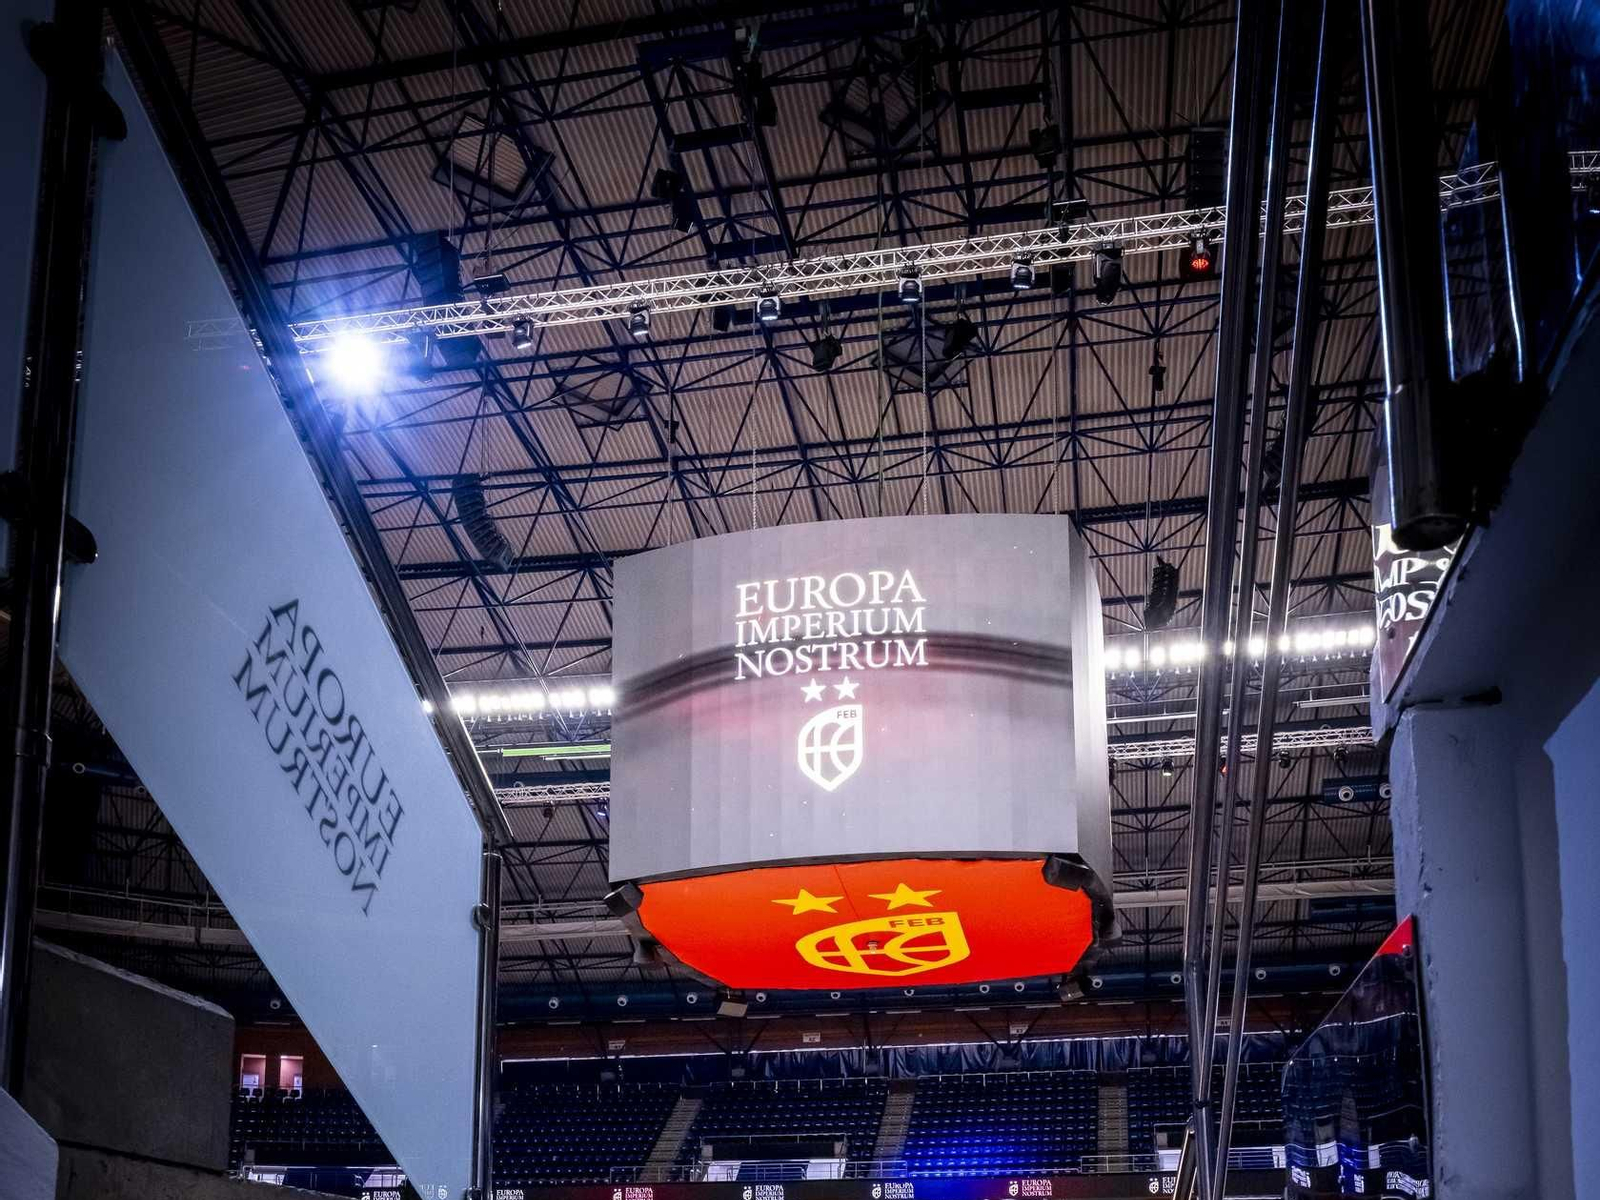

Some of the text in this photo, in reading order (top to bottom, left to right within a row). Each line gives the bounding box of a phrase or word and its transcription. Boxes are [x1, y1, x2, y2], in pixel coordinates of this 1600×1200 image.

[736, 569, 926, 618] EUROPA
[734, 607, 927, 648] IMPERIUM
[734, 639, 928, 680] NOSTRUM
[836, 709, 857, 719] FEB
[888, 917, 946, 928] FEB
